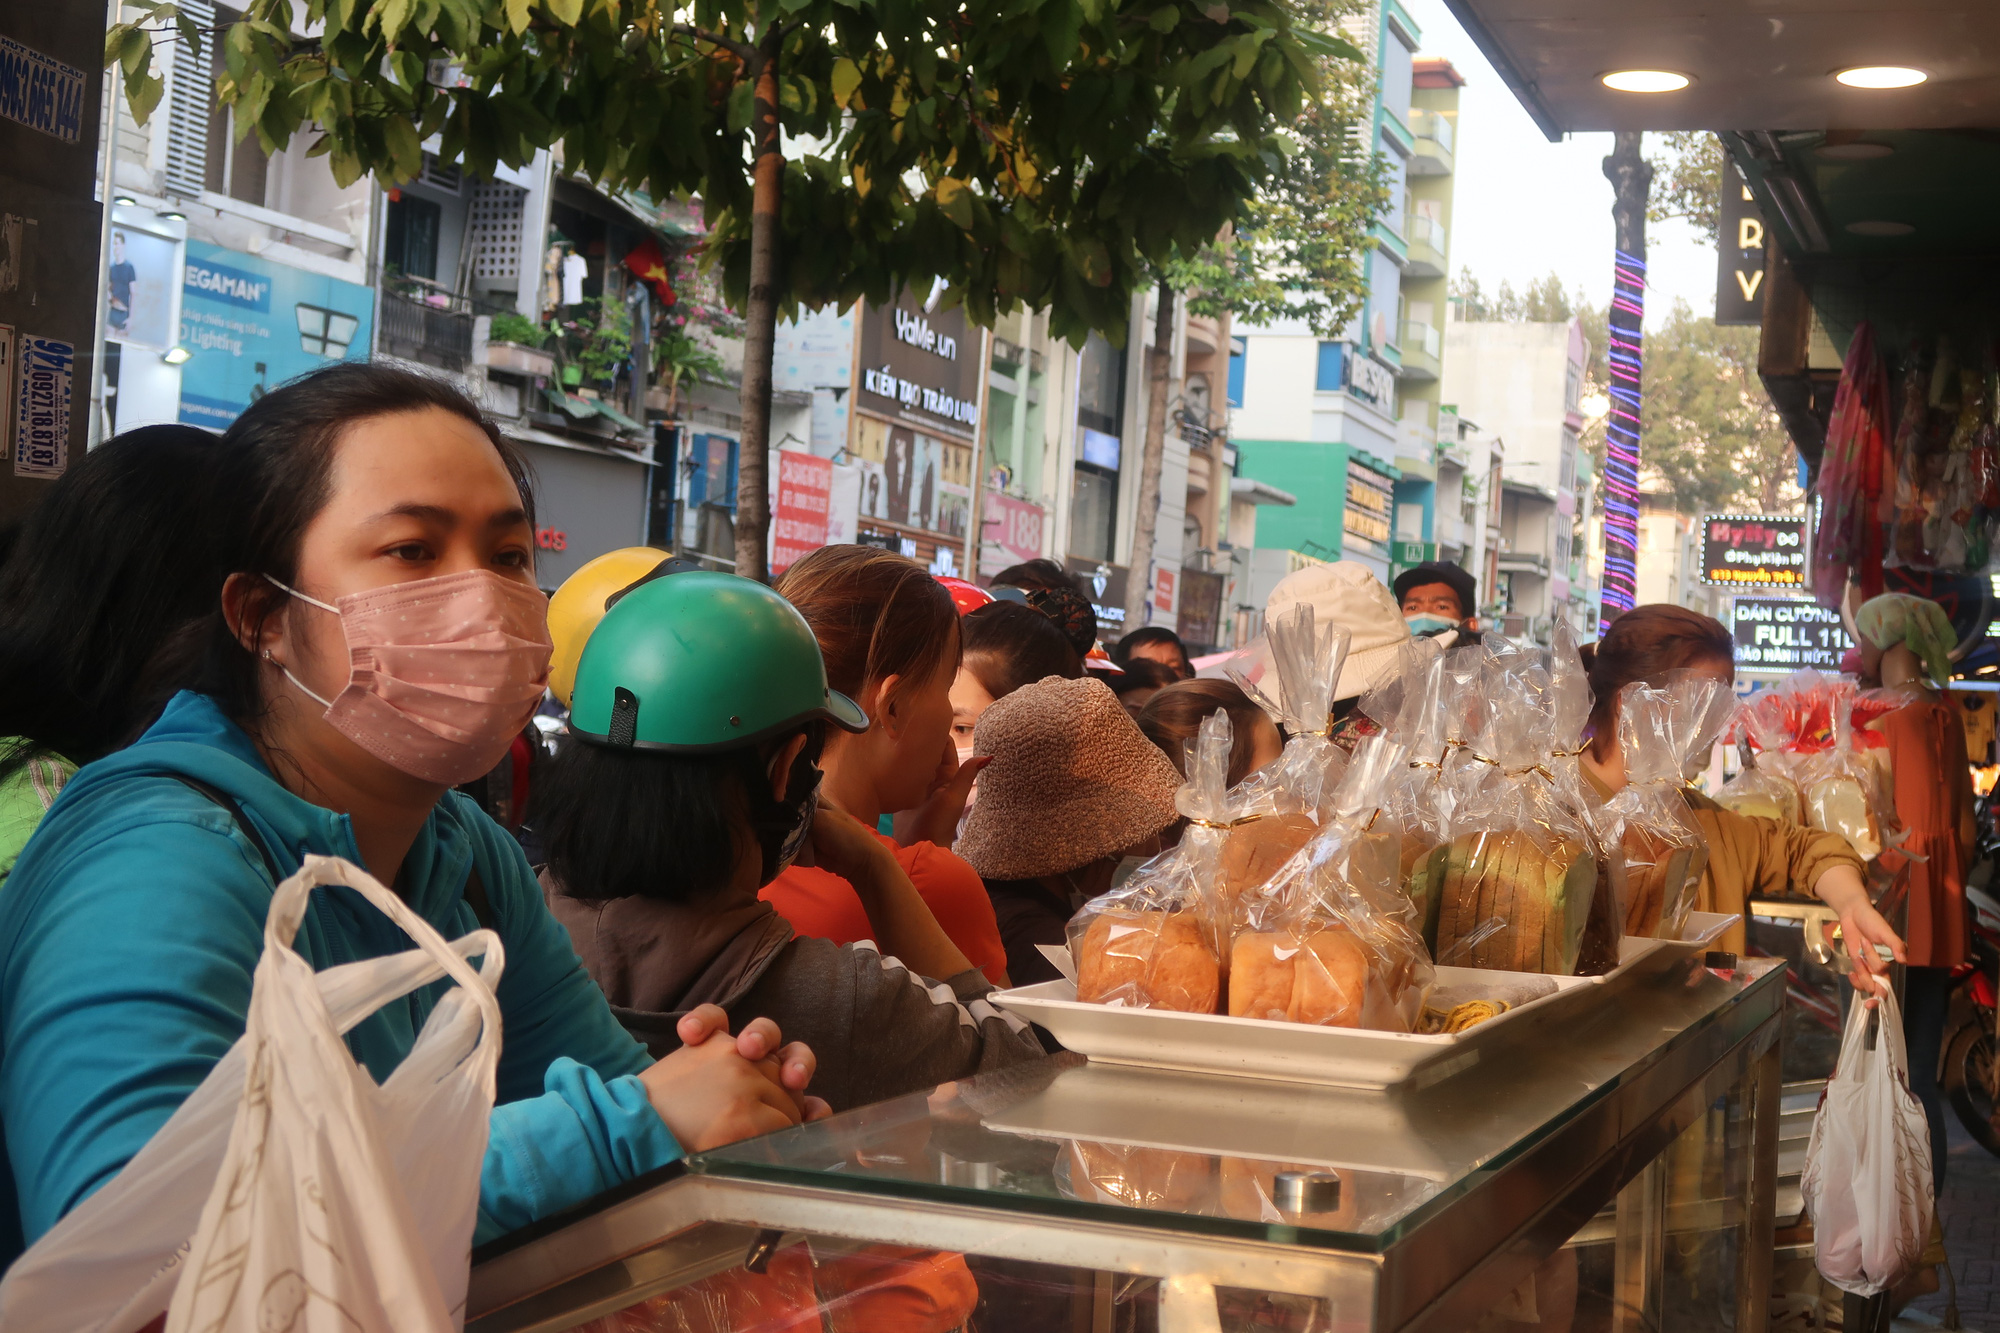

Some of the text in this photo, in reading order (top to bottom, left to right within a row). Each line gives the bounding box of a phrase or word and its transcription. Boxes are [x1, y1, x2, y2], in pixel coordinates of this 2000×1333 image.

[191, 325, 243, 357] Lighting
[865, 364, 897, 399] KIẾN
[899, 379, 921, 410] TẠO
[923, 388, 954, 417] TRÀO
[31, 371, 54, 467] 0927.18.87.87
[1008, 508, 1040, 553] 188
[1732, 567, 1771, 582] Nguyễn
[1771, 570, 1795, 583] Trãi
[1736, 603, 1840, 623] DÁN CƯỜNG
[1755, 625, 1813, 646] FULL
